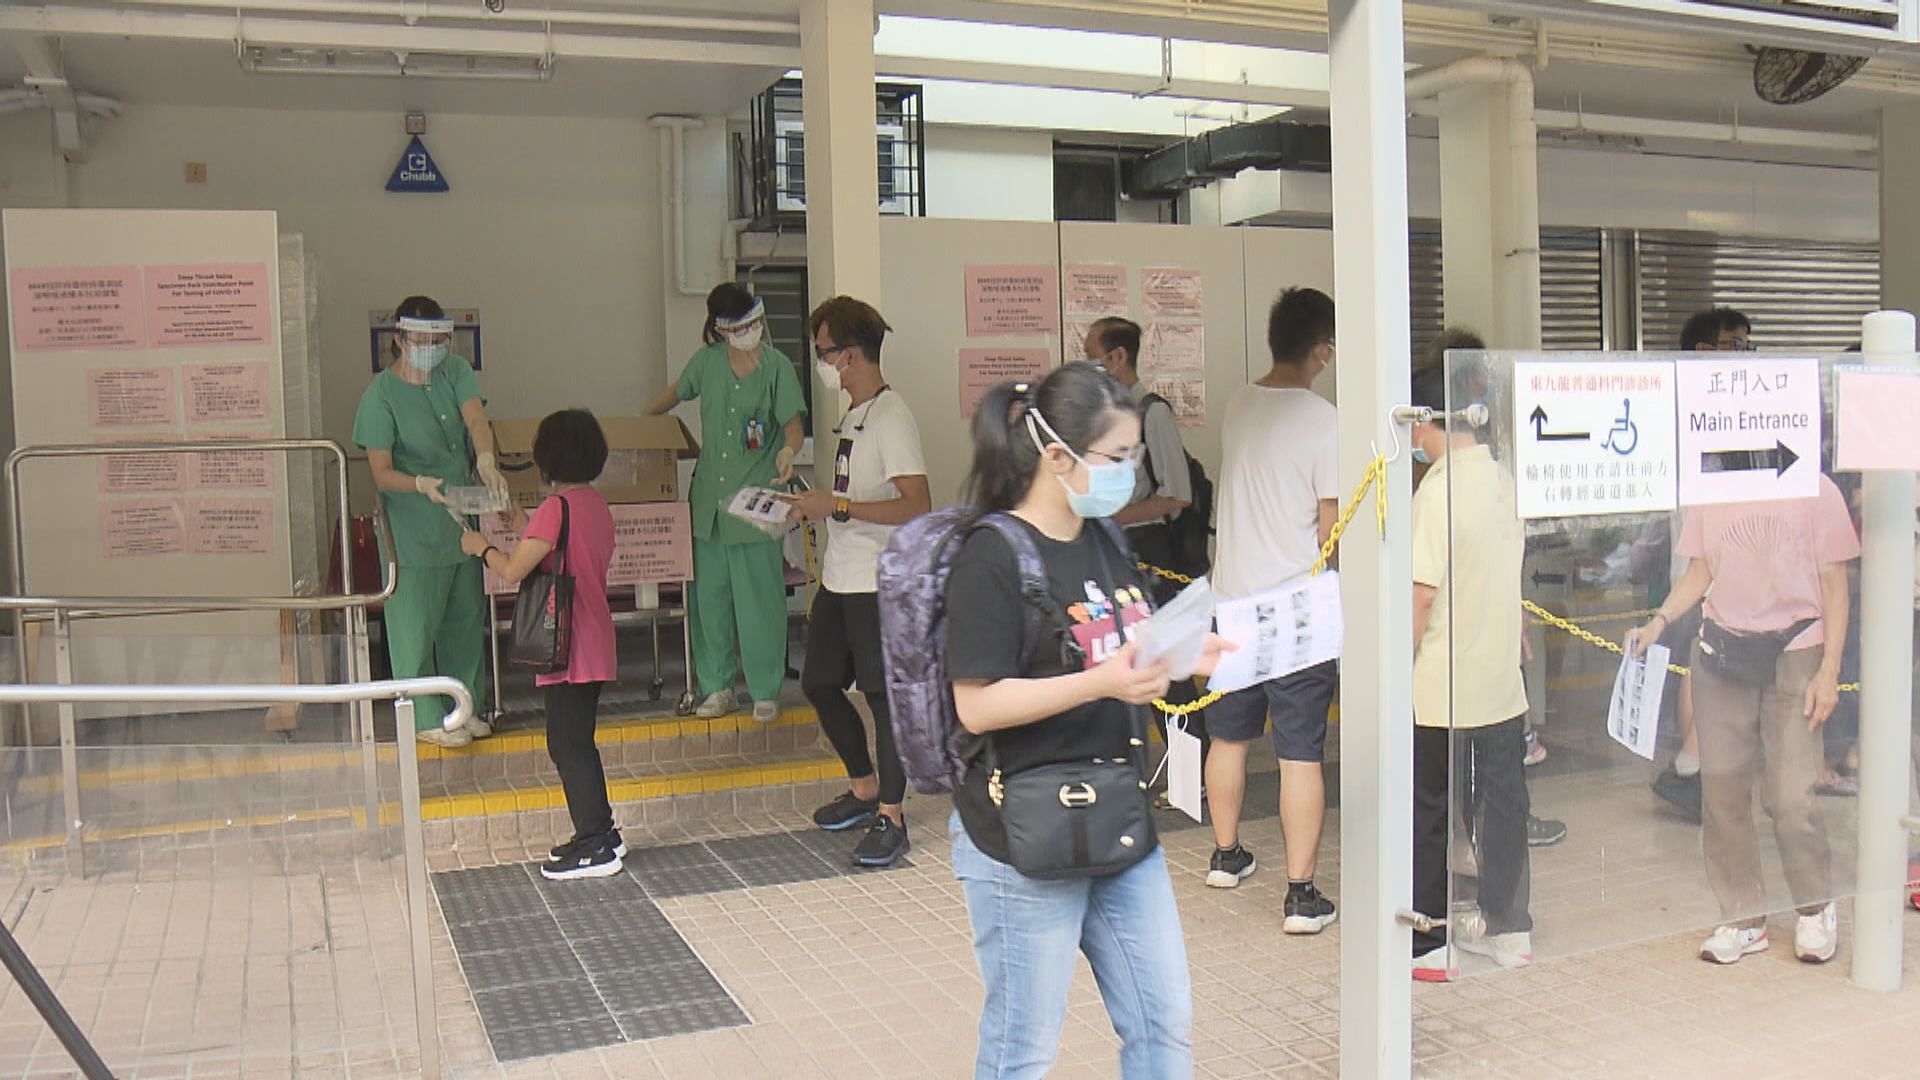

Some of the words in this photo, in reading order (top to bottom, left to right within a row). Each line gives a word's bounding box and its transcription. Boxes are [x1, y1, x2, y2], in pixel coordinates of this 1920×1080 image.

[400, 171, 436, 182] Chubb
[1530, 375, 1662, 392] 東九龍普通科門診診所
[1707, 368, 1789, 396] 正門入口
[1690, 411, 1733, 432] Main
[1739, 410, 1809, 431] Entrance
[1525, 459, 1668, 481] 輪椅使用者請往前方
[1544, 482, 1653, 502] 右轉經通道進入
